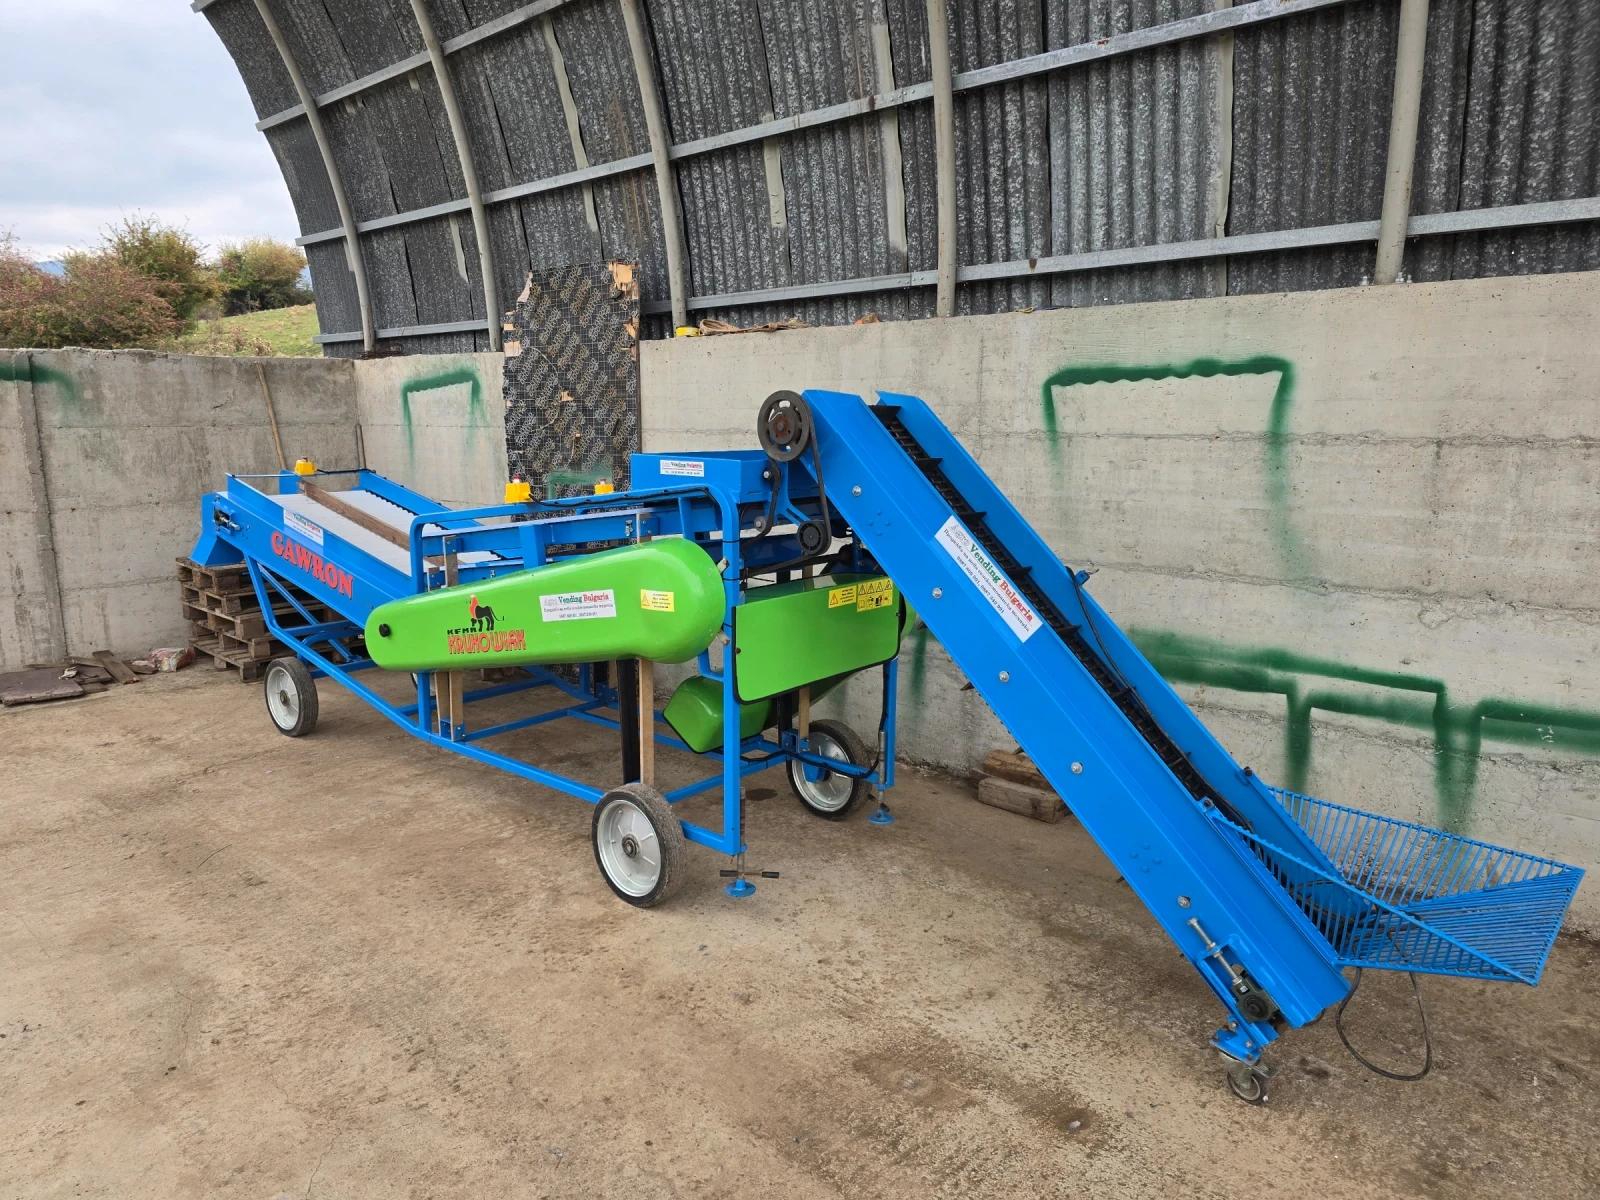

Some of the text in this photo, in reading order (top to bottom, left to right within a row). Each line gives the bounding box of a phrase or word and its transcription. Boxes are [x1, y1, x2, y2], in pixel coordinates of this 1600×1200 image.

[271, 531, 353, 600] GAWRON
[970, 543, 1001, 584] Vending
[999, 580, 1033, 622] Bulgaria
[558, 595, 583, 604] Vending
[583, 592, 609, 602] Bulgaria
[447, 627, 477, 635] KFMR
[447, 629, 526, 654] KRUKOWIAK
